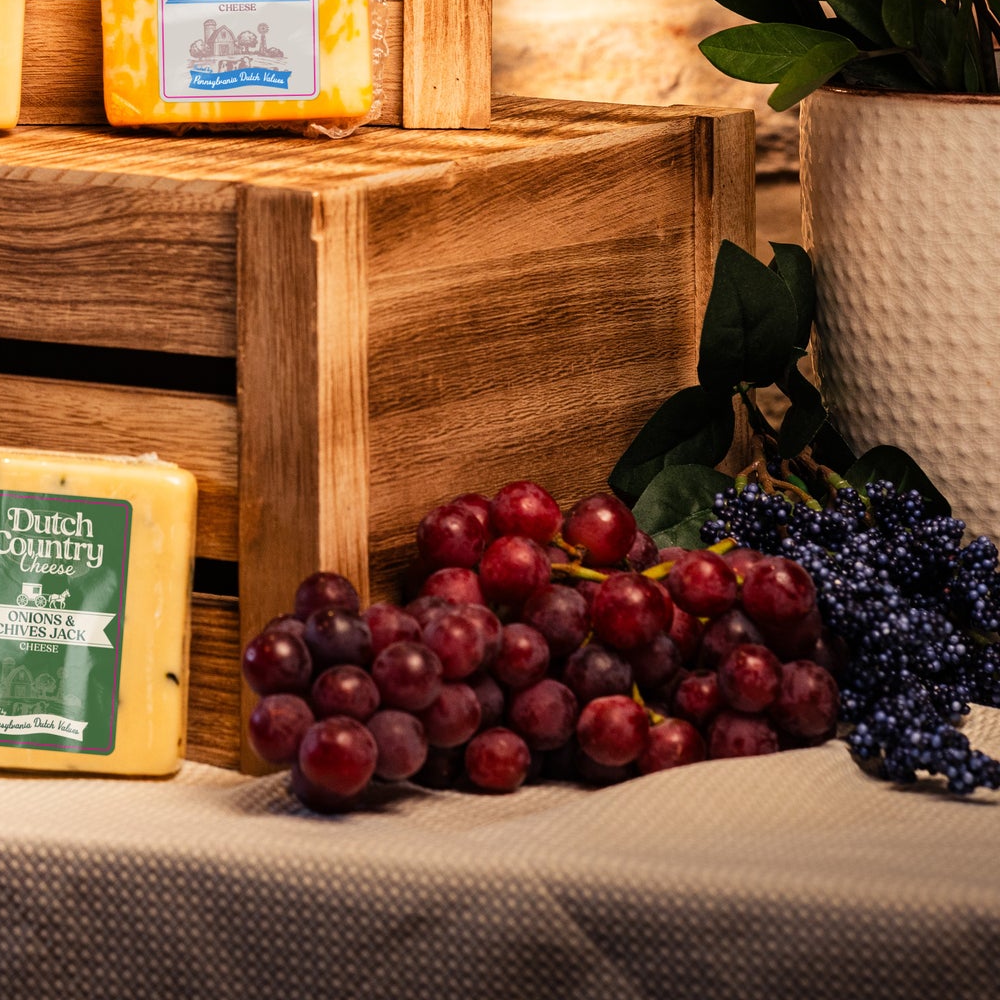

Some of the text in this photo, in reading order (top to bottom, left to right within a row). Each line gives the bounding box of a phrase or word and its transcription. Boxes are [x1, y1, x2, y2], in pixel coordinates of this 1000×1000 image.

[219, 3, 256, 12] CHEESE
[193, 72, 284, 88] Pennsylvania Dutch Values
[7, 507, 94, 537] Dutch
[20, 552, 75, 576] Cheese
[8, 610, 75, 626] ONIONS &
[50, 628, 86, 641] JACK
[20, 642, 58, 653] CHEESE
[34, 717, 55, 729] Dutch
[57, 721, 79, 734] Values
